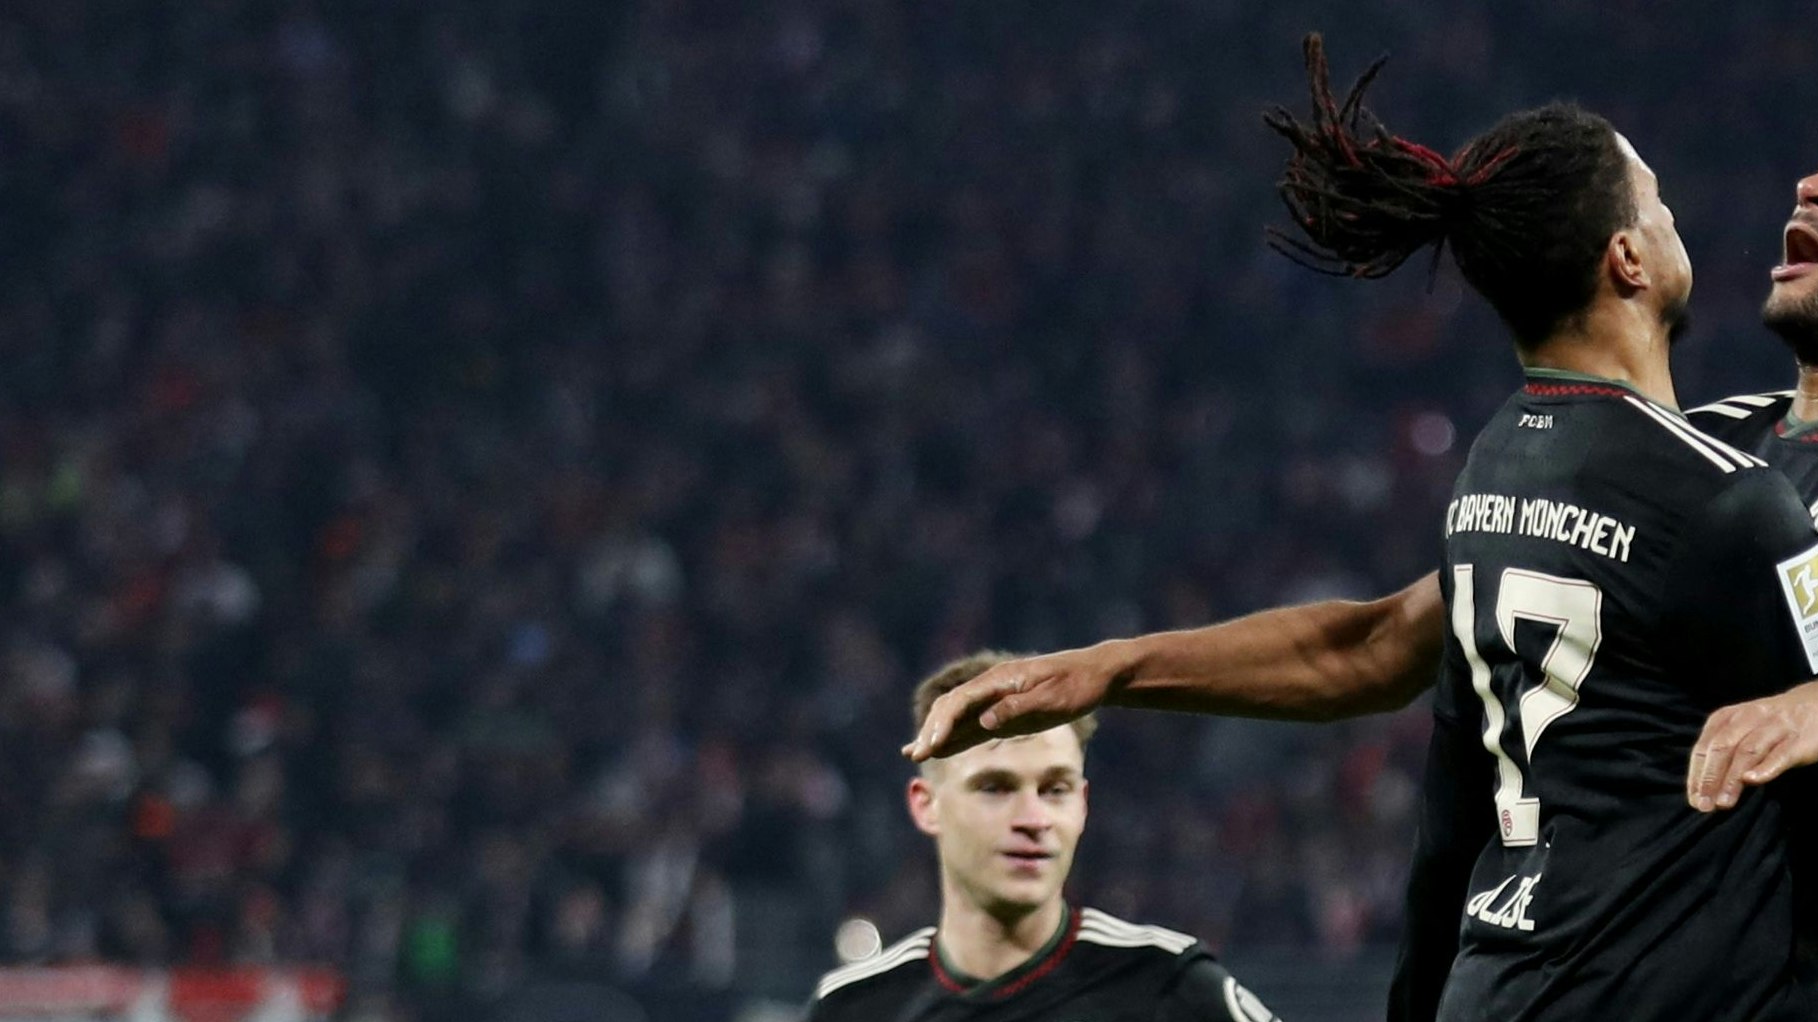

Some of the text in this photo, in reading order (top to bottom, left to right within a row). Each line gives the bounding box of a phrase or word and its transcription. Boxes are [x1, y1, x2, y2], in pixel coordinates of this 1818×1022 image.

[1445, 493, 1636, 562] C BAYERN MÜNCHEN
[1452, 563, 1603, 847] 17
